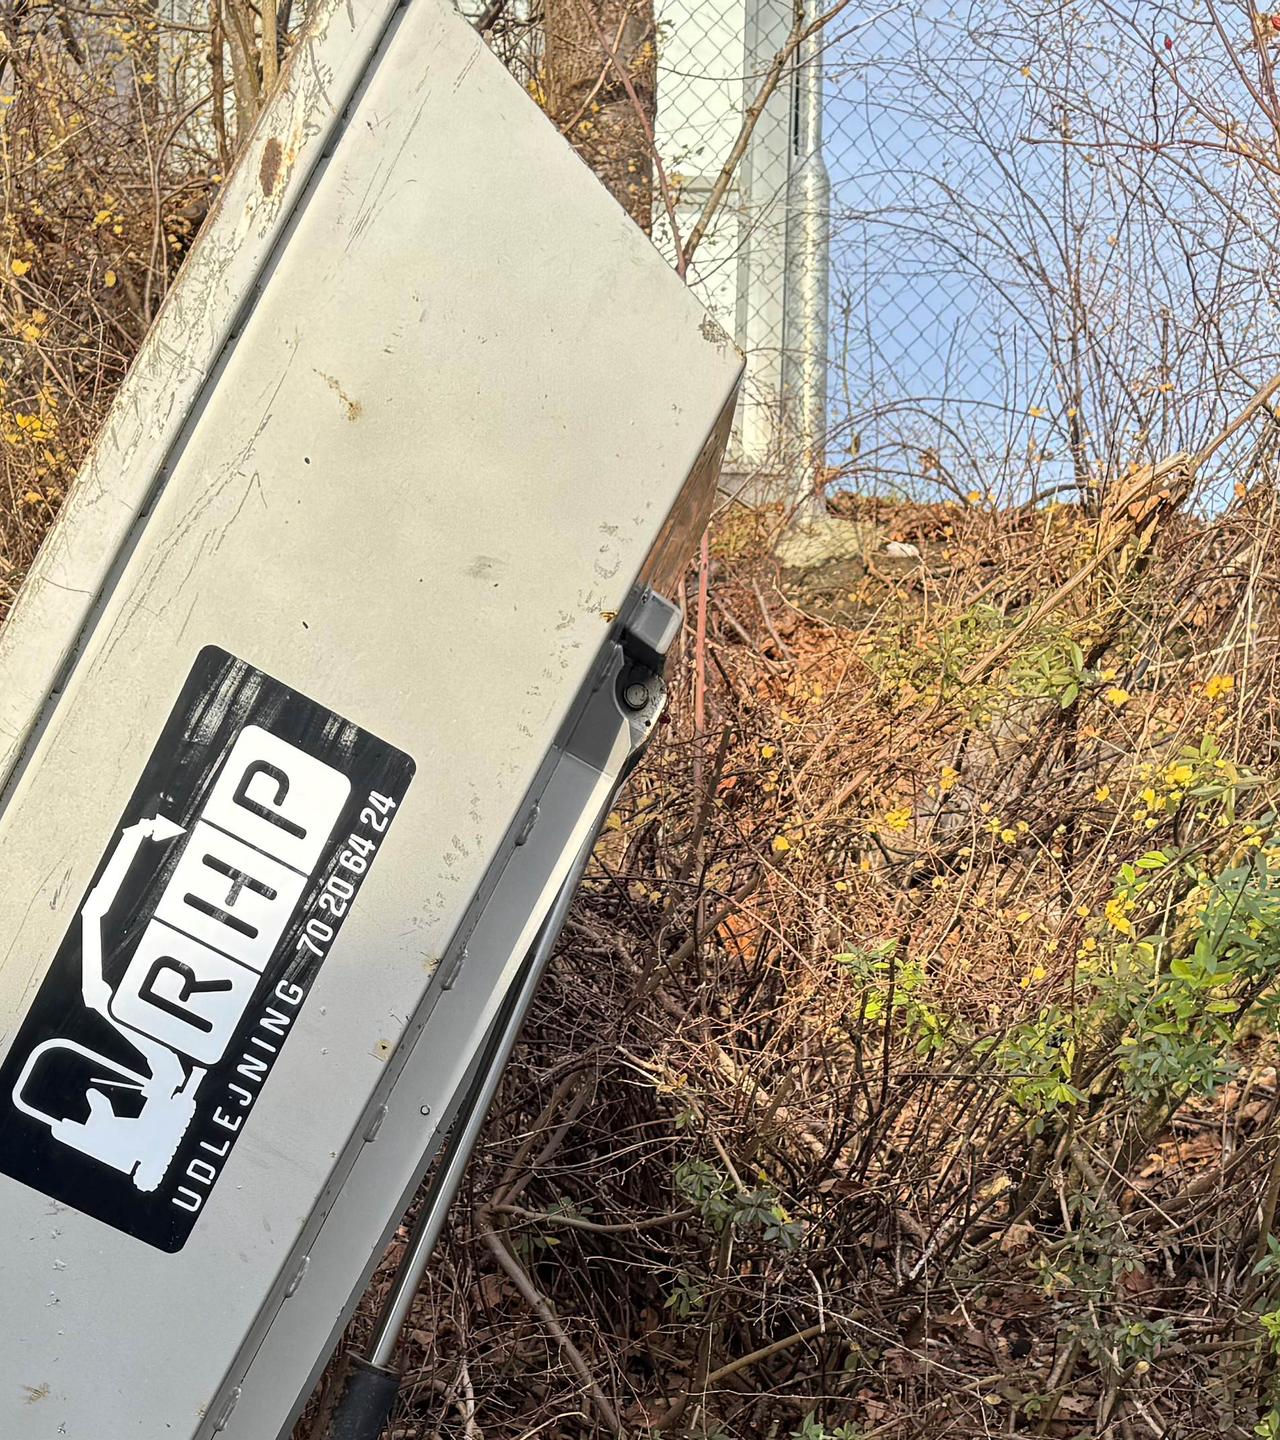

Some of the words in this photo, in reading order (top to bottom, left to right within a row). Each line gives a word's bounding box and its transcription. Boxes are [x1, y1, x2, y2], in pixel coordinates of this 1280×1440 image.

[138, 758, 308, 1033] RHP
[171, 979, 304, 1213] UDLEJNING
[296, 915, 333, 959] 70
[318, 874, 354, 916] 20
[339, 830, 376, 877] 64
[360, 788, 397, 835] 24
